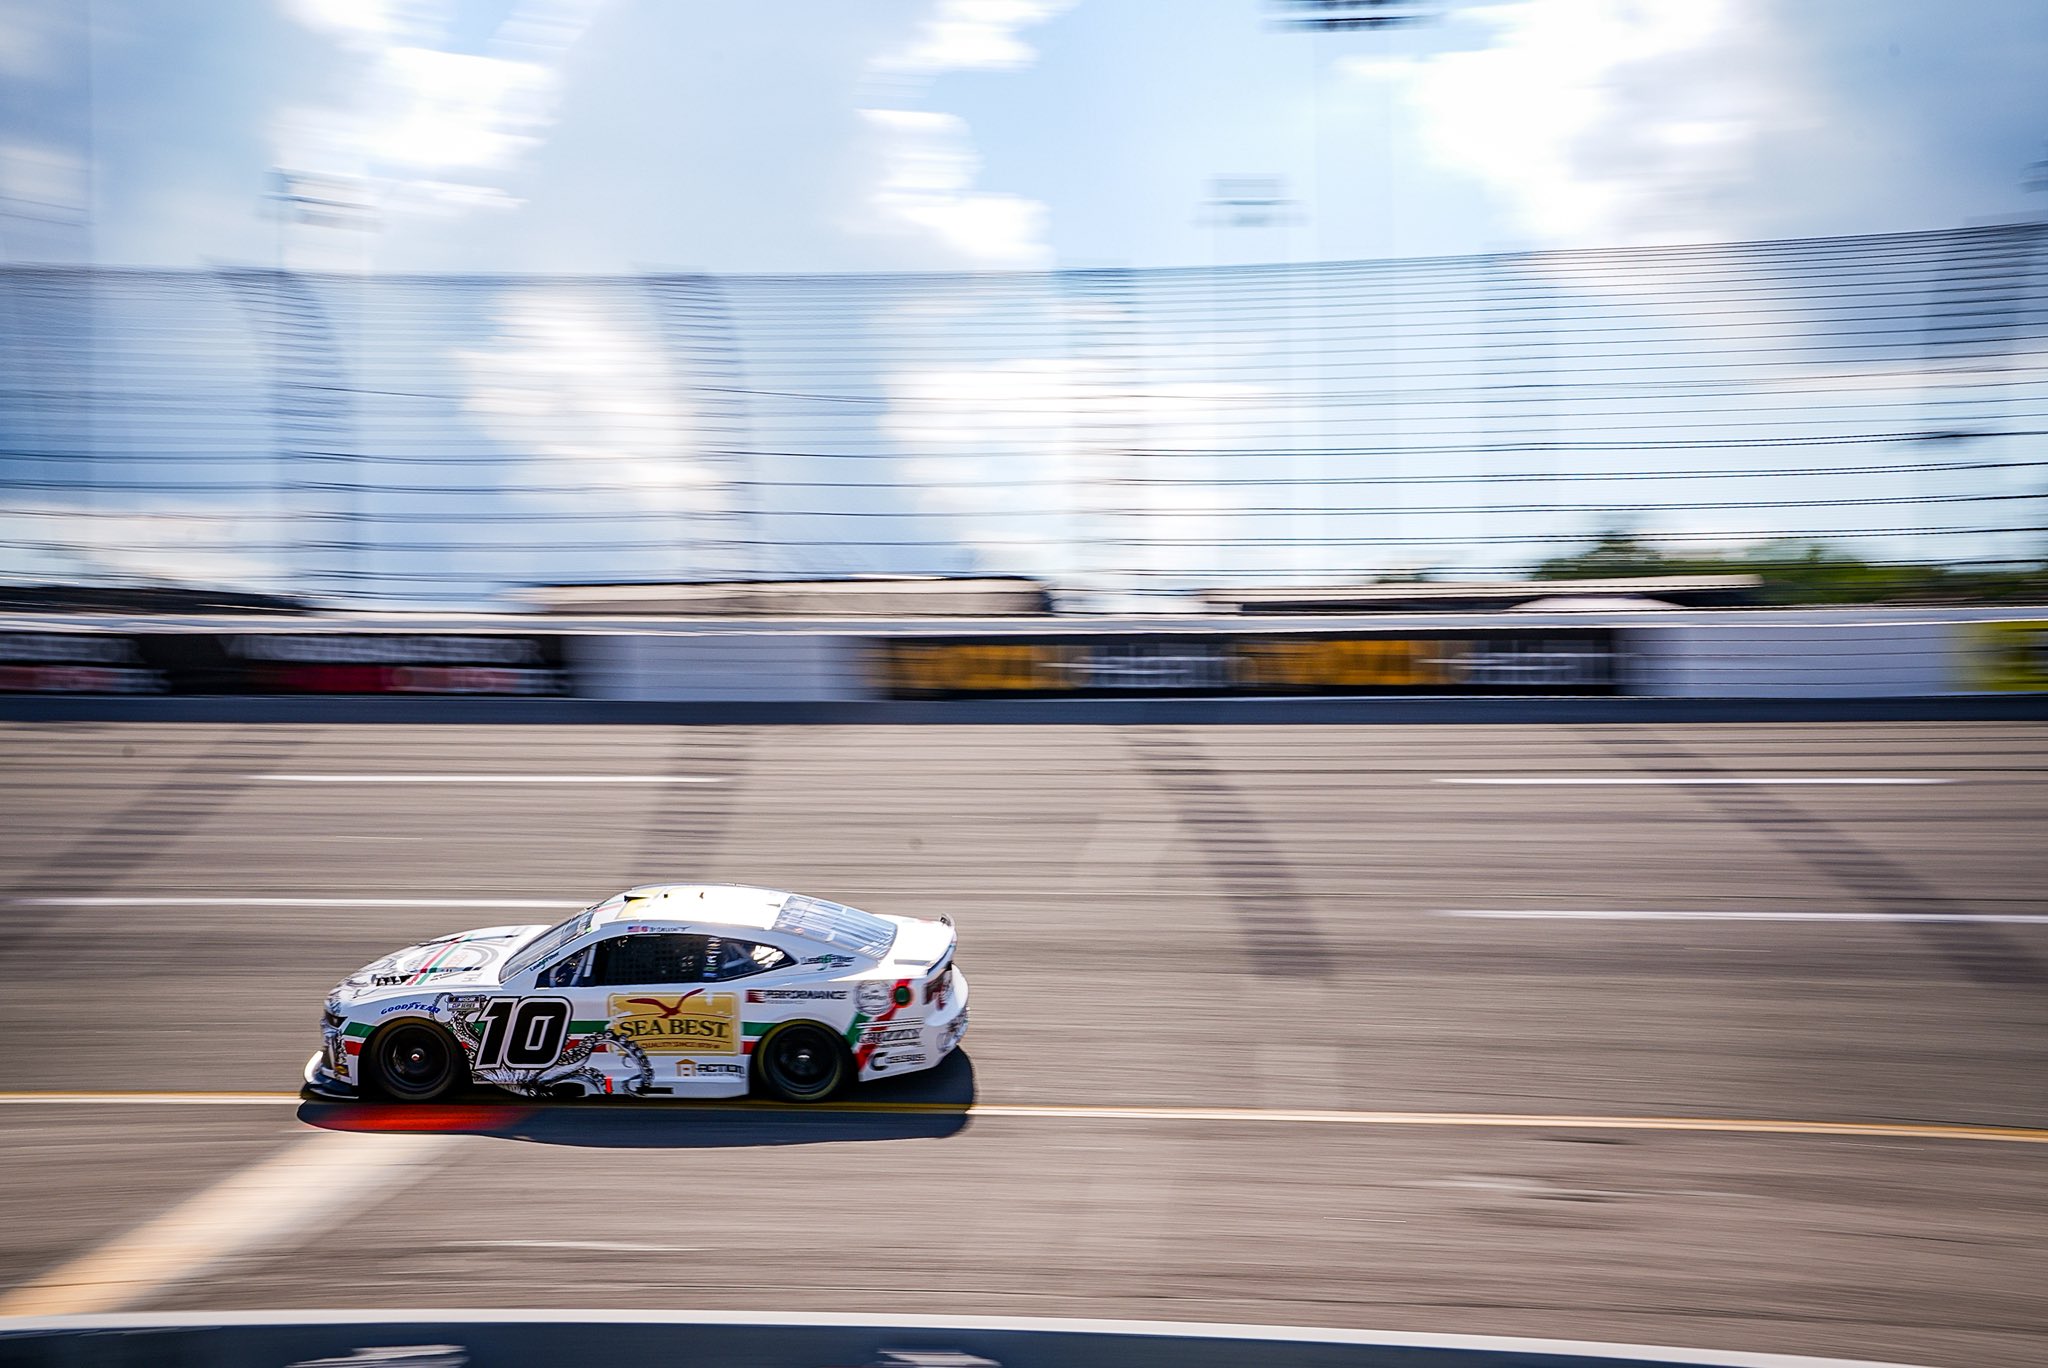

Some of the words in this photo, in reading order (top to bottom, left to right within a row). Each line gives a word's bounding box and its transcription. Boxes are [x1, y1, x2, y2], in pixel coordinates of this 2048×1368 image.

[766, 989, 848, 1000] PERFORMANCE
[380, 1001, 441, 1014] GOODYEAR
[474, 995, 574, 1070] 10
[619, 1019, 665, 1036] SEA
[668, 1019, 729, 1038] BEST
